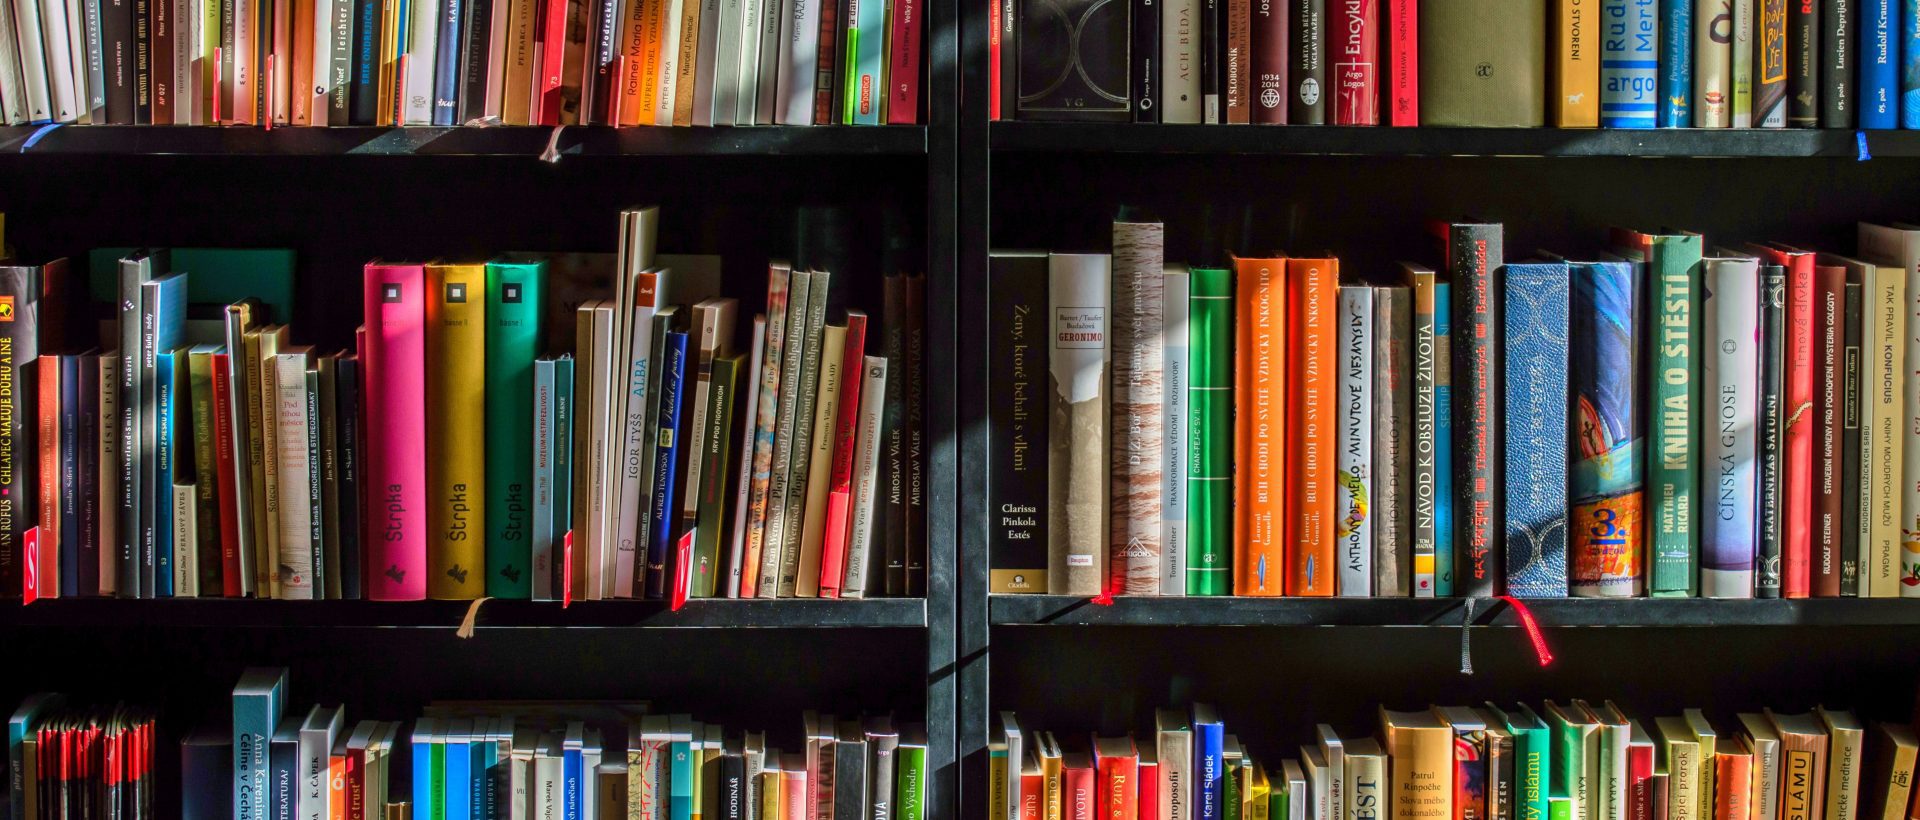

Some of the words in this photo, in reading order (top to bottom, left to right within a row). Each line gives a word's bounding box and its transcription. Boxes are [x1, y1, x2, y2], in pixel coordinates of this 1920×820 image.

[89, 2, 97, 44] MAZANEC
[338, 8, 347, 51] leichter
[602, 2, 612, 47] Podracká
[1309, 12, 1318, 40] BLAŽEK
[1346, 0, 1364, 55] Encykl
[518, 24, 526, 66] PETRARCA
[630, 24, 642, 56] Maria
[1836, 39, 1845, 69] Lucien
[1877, 31, 1887, 64] Rudolf
[600, 51, 608, 74] Dana
[647, 48, 655, 75] RUDEL
[683, 52, 691, 75] Marcel
[1180, 52, 1189, 81] ACH
[1310, 42, 1318, 70] VÁCLAV
[336, 67, 345, 84] Naef
[361, 63, 370, 84] ERIK
[627, 60, 638, 96] Rainer
[663, 61, 671, 84] REPKA
[1228, 47, 1238, 97] SLOBODNÍK
[1343, 80, 1364, 88] Logos
[1344, 70, 1363, 79] Argo
[336, 86, 344, 109] Sabina
[661, 85, 669, 110] PETER
[1607, 77, 1654, 100] argo
[1827, 292, 1835, 325] GOLGOTY
[1886, 285, 1894, 304] TAK
[1011, 304, 1030, 340] Ženy,
[1660, 275, 1689, 358] ŠTĚSTÍ
[1885, 307, 1893, 341] PRAVIL
[787, 340, 800, 365] chlpal
[806, 339, 819, 364] chlpal
[1058, 333, 1103, 343] GERONIMO
[1417, 324, 1432, 381] ŽIVOTA
[1826, 327, 1834, 364] MYSTERIA
[1013, 345, 1028, 378] ktoré
[1664, 368, 1688, 385] O
[1883, 345, 1892, 404] KONFUCIUS
[633, 358, 647, 397] ALBA
[827, 363, 837, 392] BALADY
[1825, 366, 1834, 408] POCHOPENÍ
[161, 407, 167, 415] JE
[823, 401, 832, 421] Villon
[1418, 386, 1432, 453] OBSLUZE
[1722, 384, 1736, 448] GNOSE
[1766, 394, 1778, 450] SATURNI
[1825, 410, 1833, 424] PRO
[104, 412, 113, 453] PÍSEŇ
[629, 413, 642, 443] TYŠŠ
[713, 426, 721, 439] POD
[890, 429, 900, 456] VÁLEK
[1259, 424, 1268, 438] PO
[1308, 424, 1317, 438] PO
[1664, 393, 1689, 470] KNIHA
[1825, 426, 1833, 457] KAMENY
[776, 439, 788, 469] Vyvrtil
[795, 438, 807, 468] Vyvrtil
[909, 430, 920, 458] VÁLEK
[1013, 433, 1027, 471] vlkmi
[1257, 442, 1268, 477] CHODÍ
[1306, 442, 1317, 477] CHODÍ
[1390, 429, 1399, 468] MELLO
[0, 438, 12, 485] CHLAPEC
[628, 448, 639, 479] IGOR
[657, 453, 668, 490] TENNYSON
[1823, 458, 1832, 495] STAVEBNÍ
[1883, 446, 1891, 499] MOUDRÝCH
[772, 473, 784, 499] Plop!
[791, 472, 804, 498] Plop!
[891, 460, 900, 504] MIROSLAV
[911, 461, 921, 506] MIROSLAV
[1390, 472, 1399, 487] DE
[1718, 454, 1735, 521] ČÍNSKÁ
[124, 484, 132, 508] James
[656, 492, 664, 520] ALFRED
[753, 487, 763, 522] VIDMAR
[1002, 504, 1037, 513] Clarissa
[1417, 472, 1432, 528] NÁVOD
[1663, 483, 1675, 533] MATTHIEU
[1764, 454, 1775, 541] FRATERNITAS
[383, 483, 406, 542] Štrpka
[445, 483, 470, 541] Štrpka
[501, 483, 526, 541] Štrpka
[769, 505, 782, 546] Wernisch
[788, 504, 800, 545] Wernisch
[858, 507, 866, 525] Vian
[1002, 517, 1036, 526] Pinkola
[1390, 489, 1400, 556] ANTHONY
[1590, 508, 1626, 538] 3.
[1677, 495, 1688, 533] RICARD
[856, 529, 864, 549] Boris
[1008, 529, 1030, 540] Estés
[1169, 526, 1177, 553] Keltner
[1823, 513, 1831, 544] STEINER
[766, 548, 777, 566] Ivan
[785, 547, 796, 565] Ivan
[1169, 555, 1177, 578] Tomáš
[1823, 545, 1831, 575] RUDOLF
[1882, 540, 1890, 578] PRAGMA
[240, 734, 250, 771] Céline
[254, 733, 265, 764] Anna
[311, 757, 319, 787] ČAPEK
[1203, 755, 1214, 789] Sládek
[1411, 771, 1435, 779] Patrul
[1524, 751, 1539, 802] islámu
[1679, 752, 1691, 790] prorok
[1762, 752, 1772, 778] Robin
[1839, 746, 1852, 791] meditace
[312, 790, 319, 798] K.
[730, 778, 738, 818] HODINÁŘ
[905, 769, 918, 809] Východu
[1113, 775, 1125, 805] RUIZ
[1203, 791, 1213, 817] Karel
[1399, 796, 1422, 805] Slova
[1499, 781, 1507, 804] ZEN
[1761, 781, 1772, 815] Sharma
[1026, 794, 1036, 817] RUIZ
